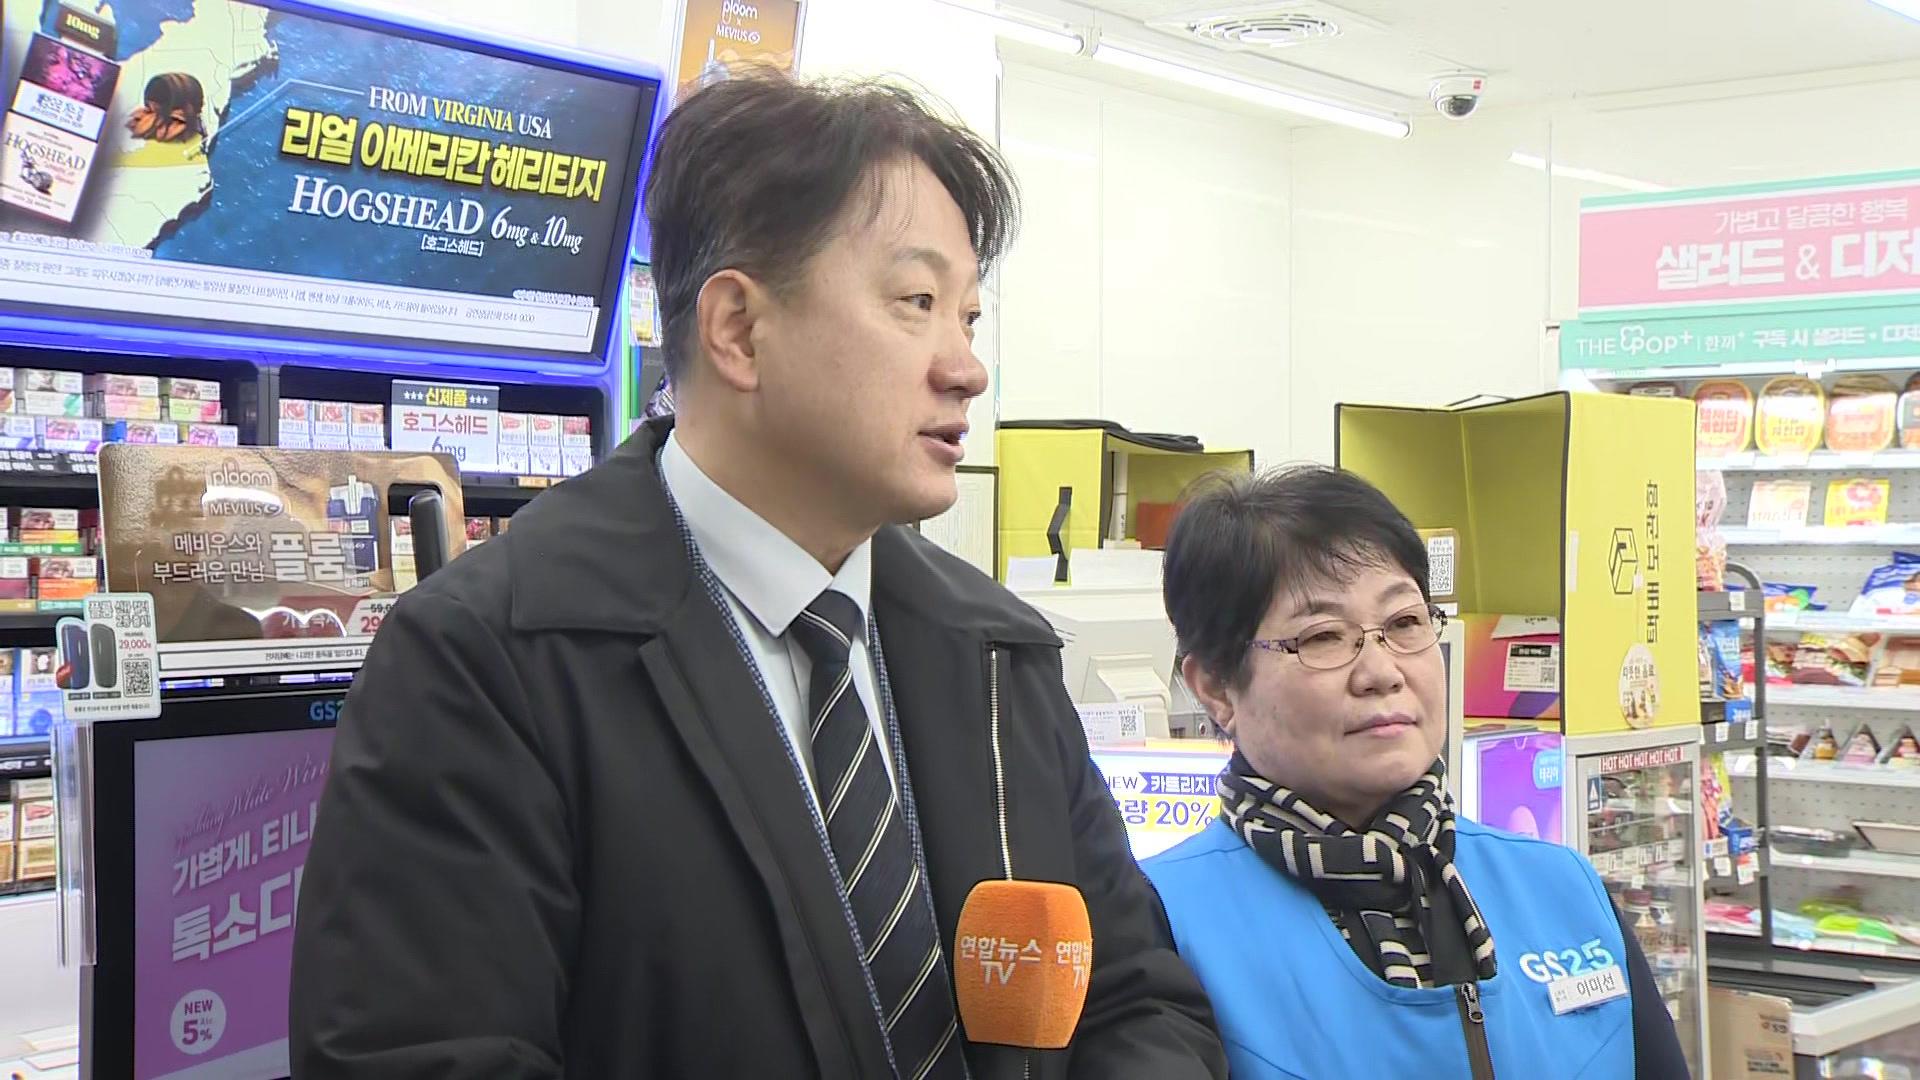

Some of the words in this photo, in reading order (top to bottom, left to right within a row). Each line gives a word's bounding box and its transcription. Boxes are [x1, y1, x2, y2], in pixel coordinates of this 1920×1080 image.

[66, 13, 100, 39] 10mg
[716, 25, 748, 42] MEVIUS
[368, 85, 427, 117] FROM
[433, 98, 513, 132] VIRGINIA
[518, 114, 552, 139] USA
[5, 132, 87, 171] HOGSHEAD
[281, 107, 358, 165] 리얼
[360, 122, 491, 185] 아메리칸
[491, 145, 606, 202] 헤리티지
[287, 174, 485, 235] HOGSHEAD
[490, 206, 529, 247] 6mg
[530, 232, 540, 245] &
[541, 215, 583, 254] 10mg
[1714, 209, 1779, 235] 가볍고
[1786, 202, 1855, 230] 달콤한
[1860, 197, 1909, 223] 행복
[421, 234, 484, 257] [호그스헤드]
[1656, 238, 1785, 291] 샐러드
[1794, 243, 1821, 281] &
[1576, 337, 1616, 356] THE
[1752, 328, 1788, 348] 구독
[1791, 327, 1809, 347] 시
[425, 386, 468, 407] 신제품
[403, 411, 489, 435] 호그스헤드
[210, 463, 272, 488] ploom
[210, 502, 264, 516] MEVIUS
[1646, 480, 1660, 571] 보관함
[174, 533, 262, 556] 메비우스와
[270, 532, 347, 584] 플룸
[152, 562, 224, 585] 부드러운
[229, 561, 265, 584] 만남
[1646, 582, 1660, 643] 택배
[1602, 756, 1617, 771] HOT
[1619, 754, 1632, 769] HOT
[1633, 752, 1648, 767] HOT
[1649, 750, 1663, 765] HOT
[1664, 748, 1678, 763] HOT
[1150, 775, 1209, 793] 카트리지
[1117, 799, 1148, 824] 량
[1155, 800, 1212, 826] 20%
[960, 934, 1042, 962] 연합뉴스
[1519, 938, 1614, 983] GS25
[980, 961, 1016, 985] TV
[1576, 972, 1616, 997] 이미선
[184, 999, 213, 1016] NEW
